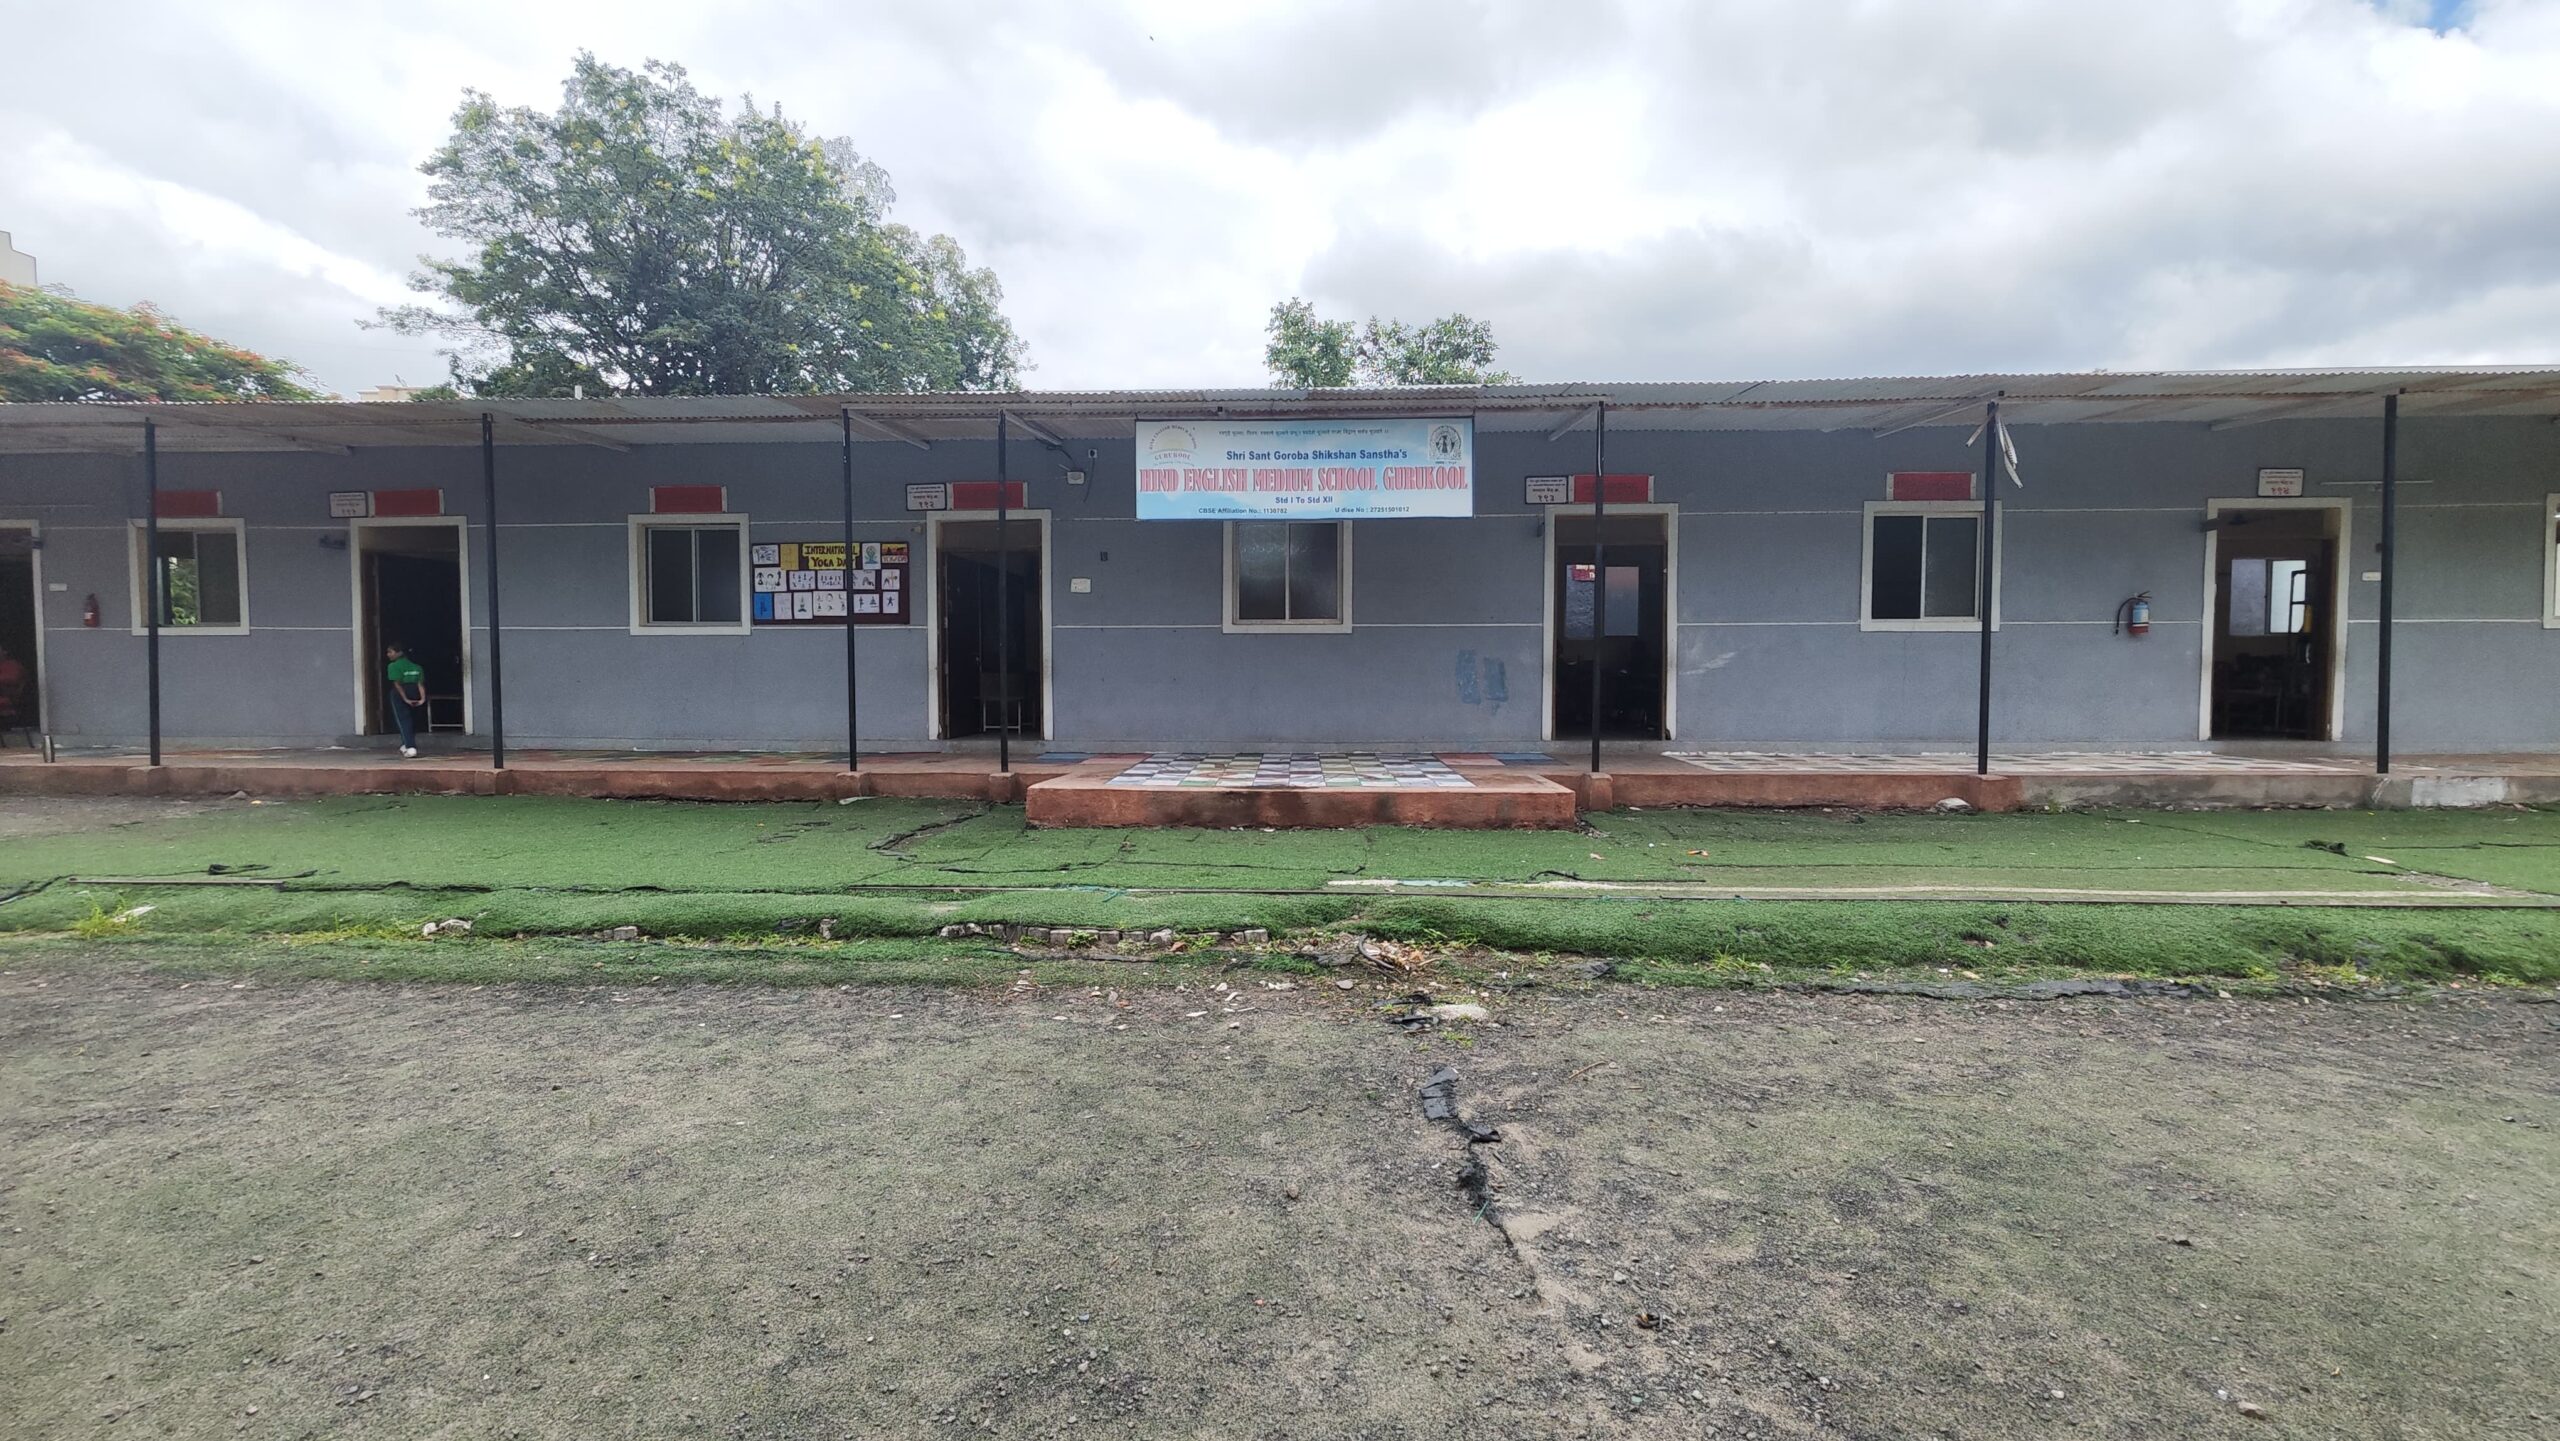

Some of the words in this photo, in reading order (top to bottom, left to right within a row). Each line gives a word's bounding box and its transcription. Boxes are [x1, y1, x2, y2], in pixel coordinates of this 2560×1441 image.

[1226, 450, 1246, 460] Shri
[1248, 450, 1271, 460] Sant
[1273, 450, 1309, 460] Goroba
[1312, 449, 1357, 460] Shikshan
[1359, 448, 1408, 459] Sanstha's
[1139, 468, 1180, 492] HIND
[1183, 468, 1248, 492] ENGLISH
[1252, 468, 1313, 492] MEDIUM
[1317, 467, 1378, 491] SCHOOL
[1382, 465, 1468, 490] GURUKOOL
[1275, 496, 1289, 504] Std
[1295, 496, 1305, 504] To
[1307, 496, 1321, 504] Std
[1322, 495, 1333, 503] XII
[804, 545, 858, 555] INTERNATIOL
[811, 556, 835, 567] YOGA
